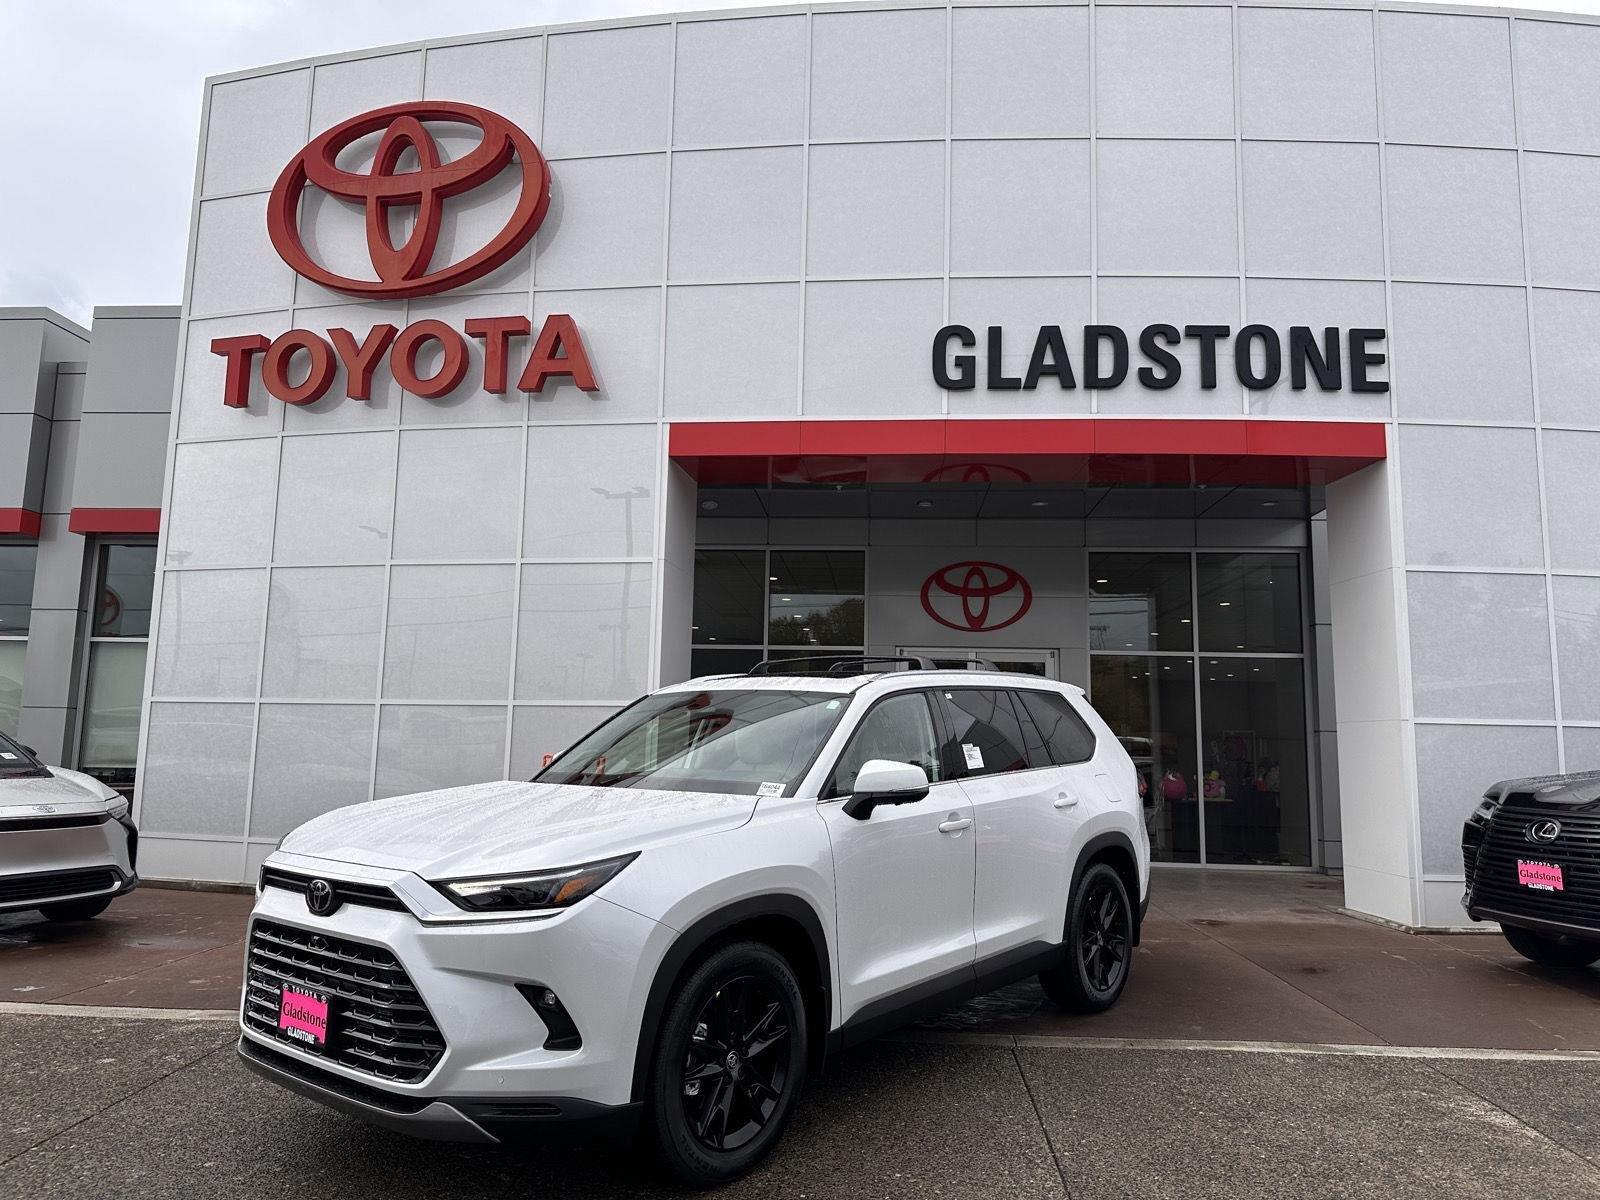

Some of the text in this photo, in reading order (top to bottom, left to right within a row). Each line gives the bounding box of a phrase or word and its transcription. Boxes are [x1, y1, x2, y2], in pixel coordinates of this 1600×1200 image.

[211, 314, 599, 408] TOYOTA
[932, 323, 1390, 393] GLADSTONE
[1520, 870, 1561, 882] Gladstone
[292, 986, 317, 999] TOYOTA
[282, 1001, 326, 1029] Gladstone
[288, 1026, 315, 1044] GLADSTONE
